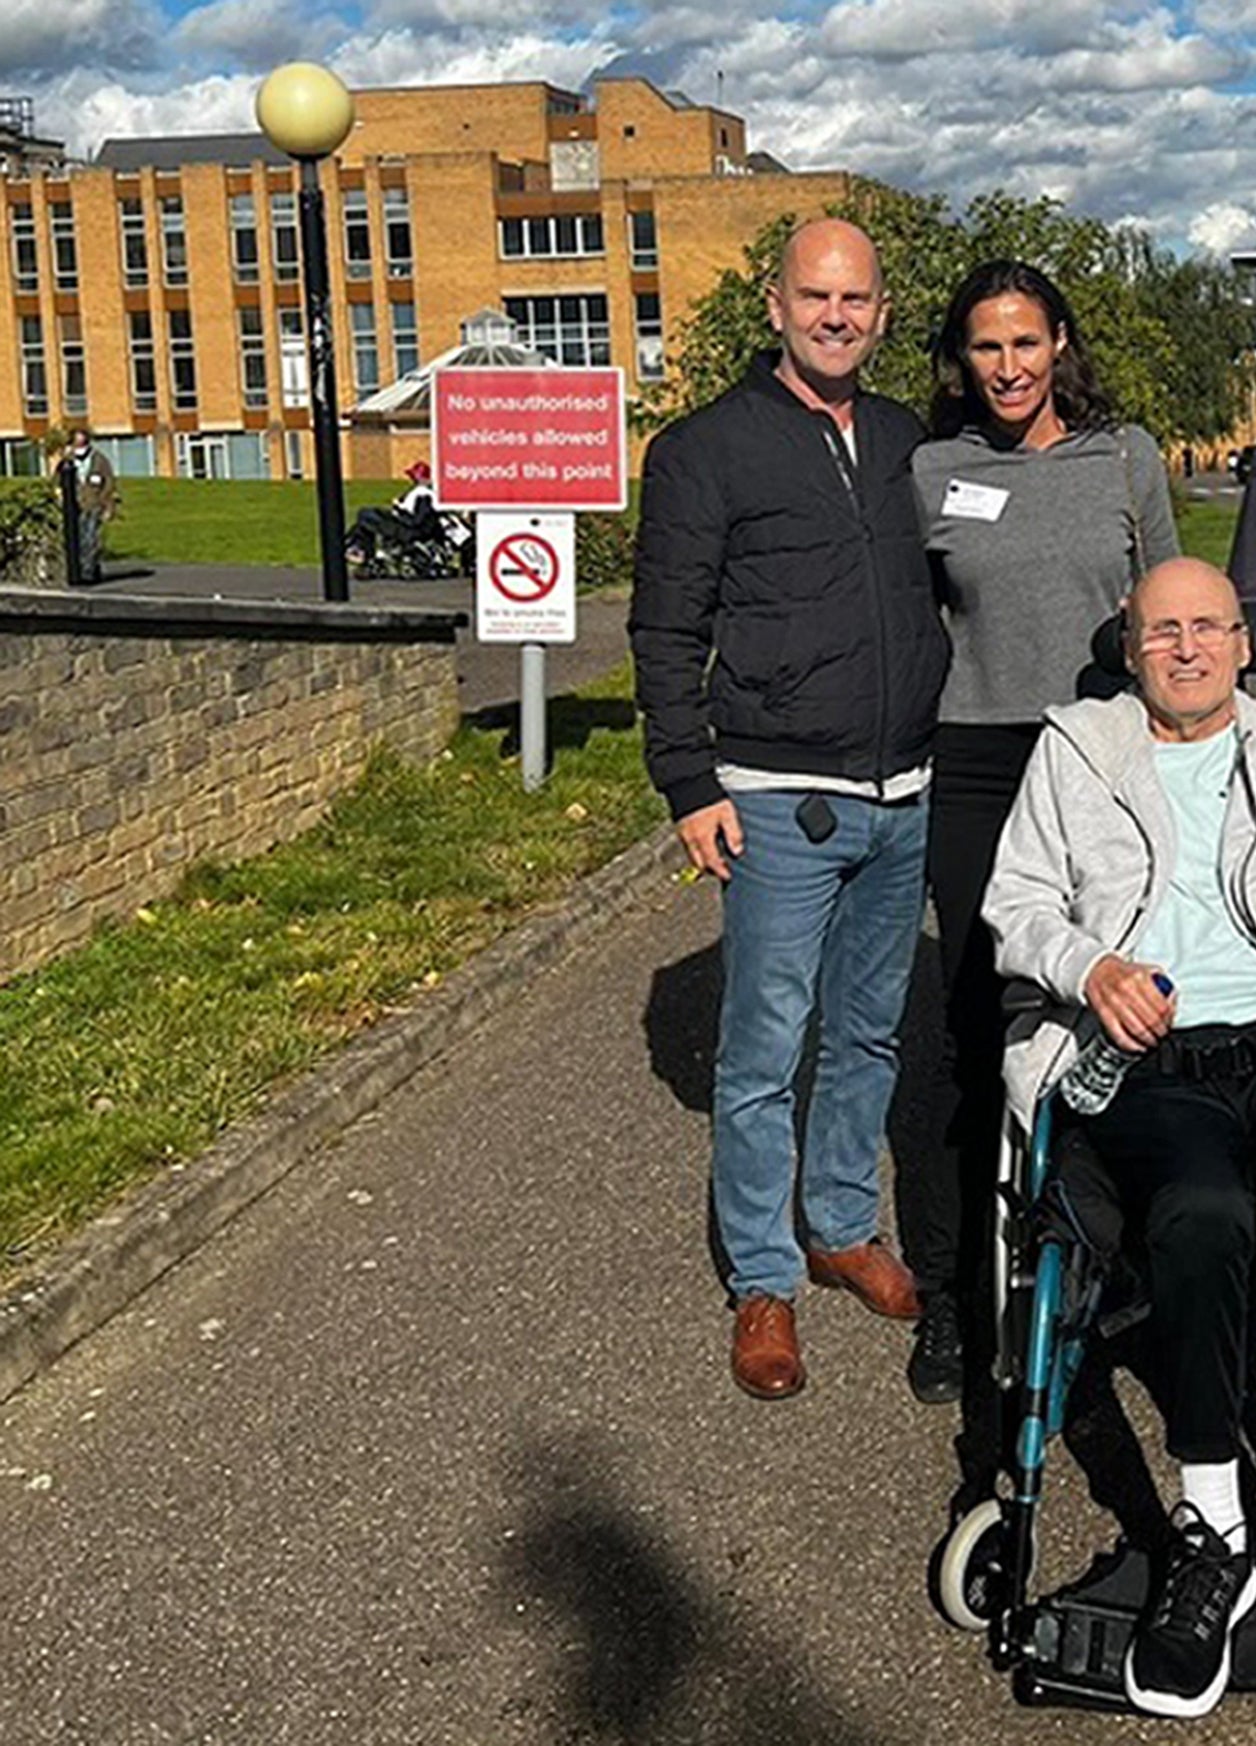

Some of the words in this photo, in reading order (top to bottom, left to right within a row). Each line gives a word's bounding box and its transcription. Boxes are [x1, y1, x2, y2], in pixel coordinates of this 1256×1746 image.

[447, 394, 476, 411] No
[479, 394, 609, 411] unauthorised
[449, 429, 528, 446] vehicles
[532, 429, 608, 446] allowed
[444, 462, 518, 482] beyond
[522, 462, 557, 480] this
[562, 462, 613, 483] point
